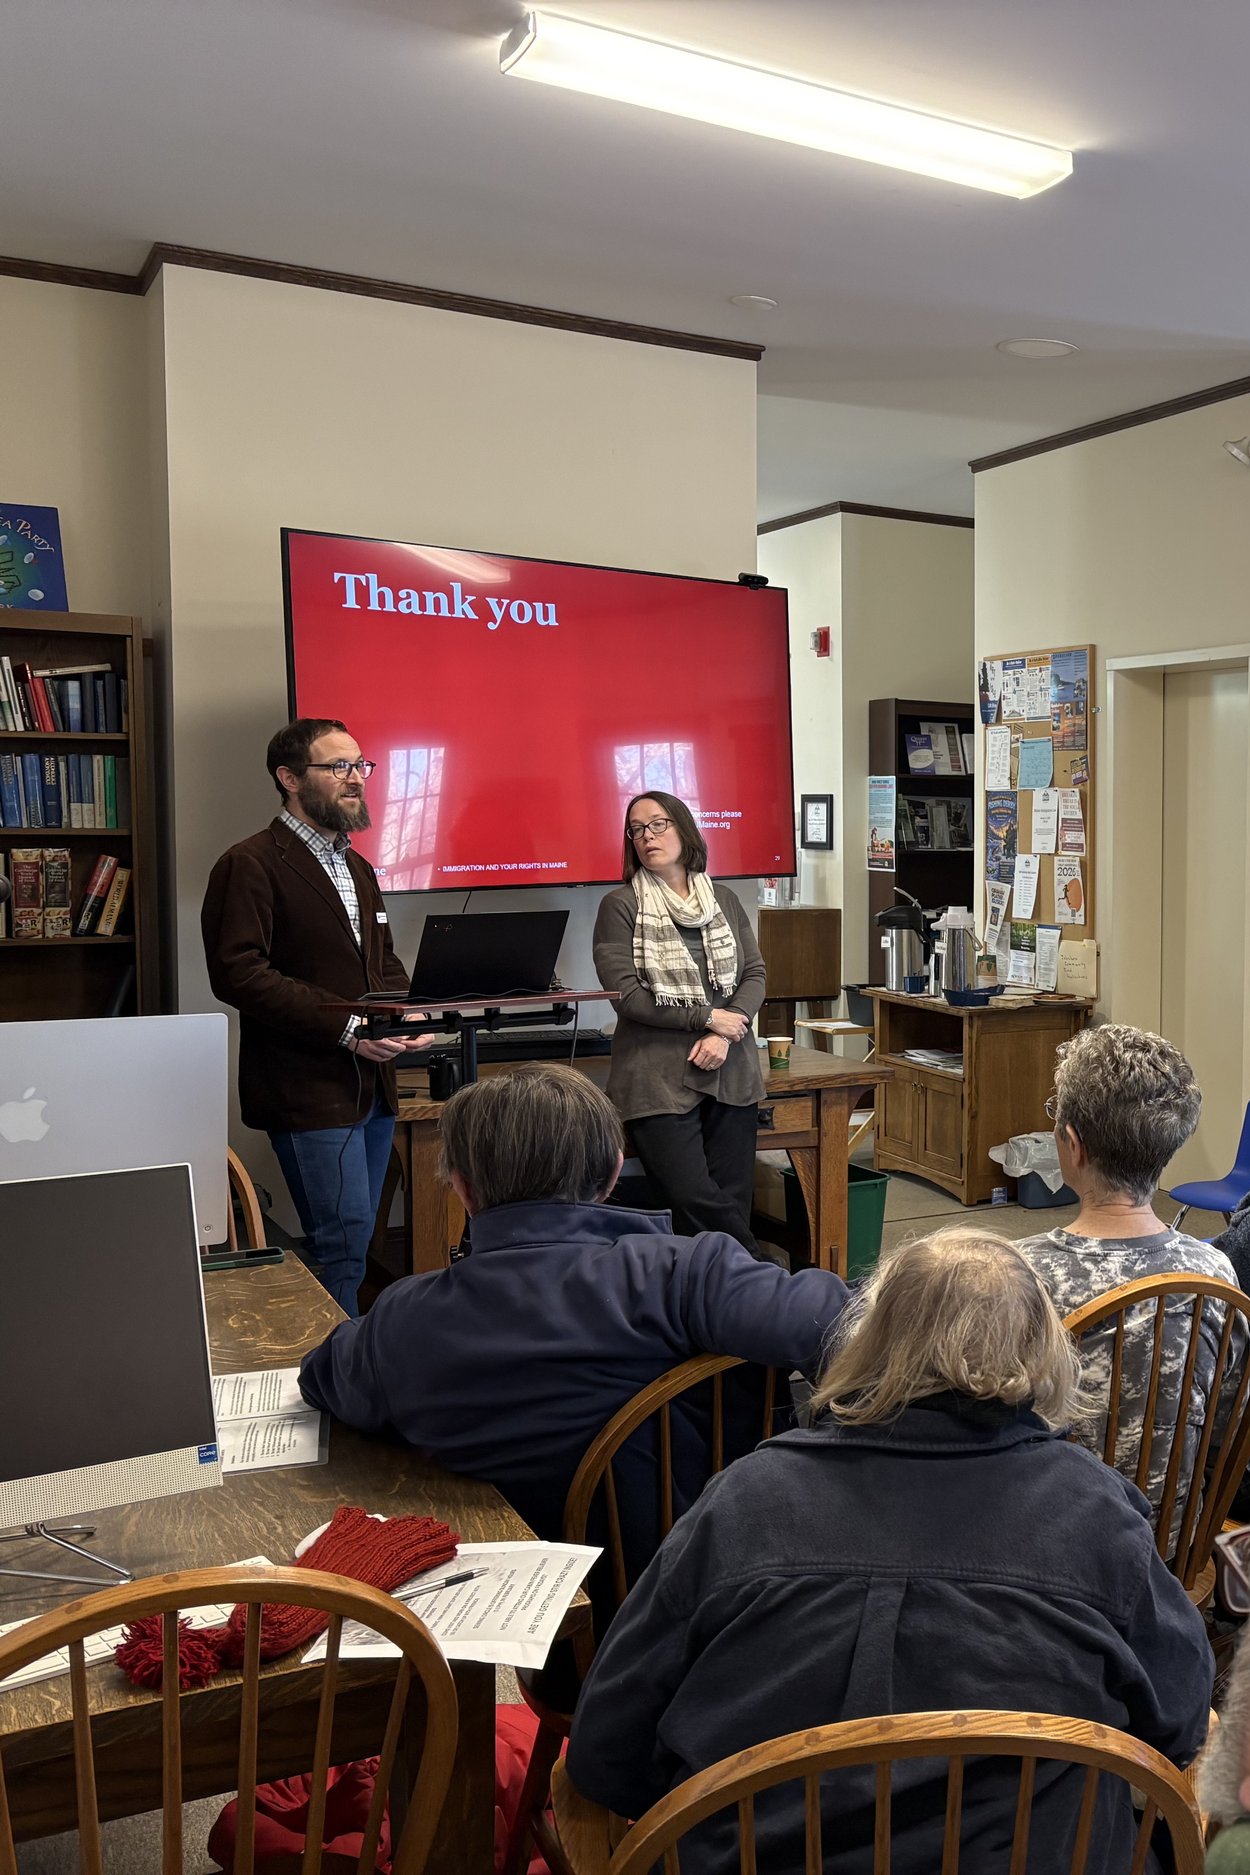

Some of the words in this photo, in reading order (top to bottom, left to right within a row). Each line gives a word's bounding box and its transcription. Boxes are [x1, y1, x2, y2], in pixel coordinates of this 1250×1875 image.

[334, 572, 479, 620] Thank
[486, 597, 559, 630] you
[721, 810, 742, 818] please
[1057, 867, 1076, 876] 2026
[555, 1570, 568, 1583] CRAZY
[550, 1584, 560, 1592] STIR
[539, 1592, 556, 1612] GETTING
[534, 1612, 545, 1622] YOU
[528, 1624, 539, 1634] ARE
